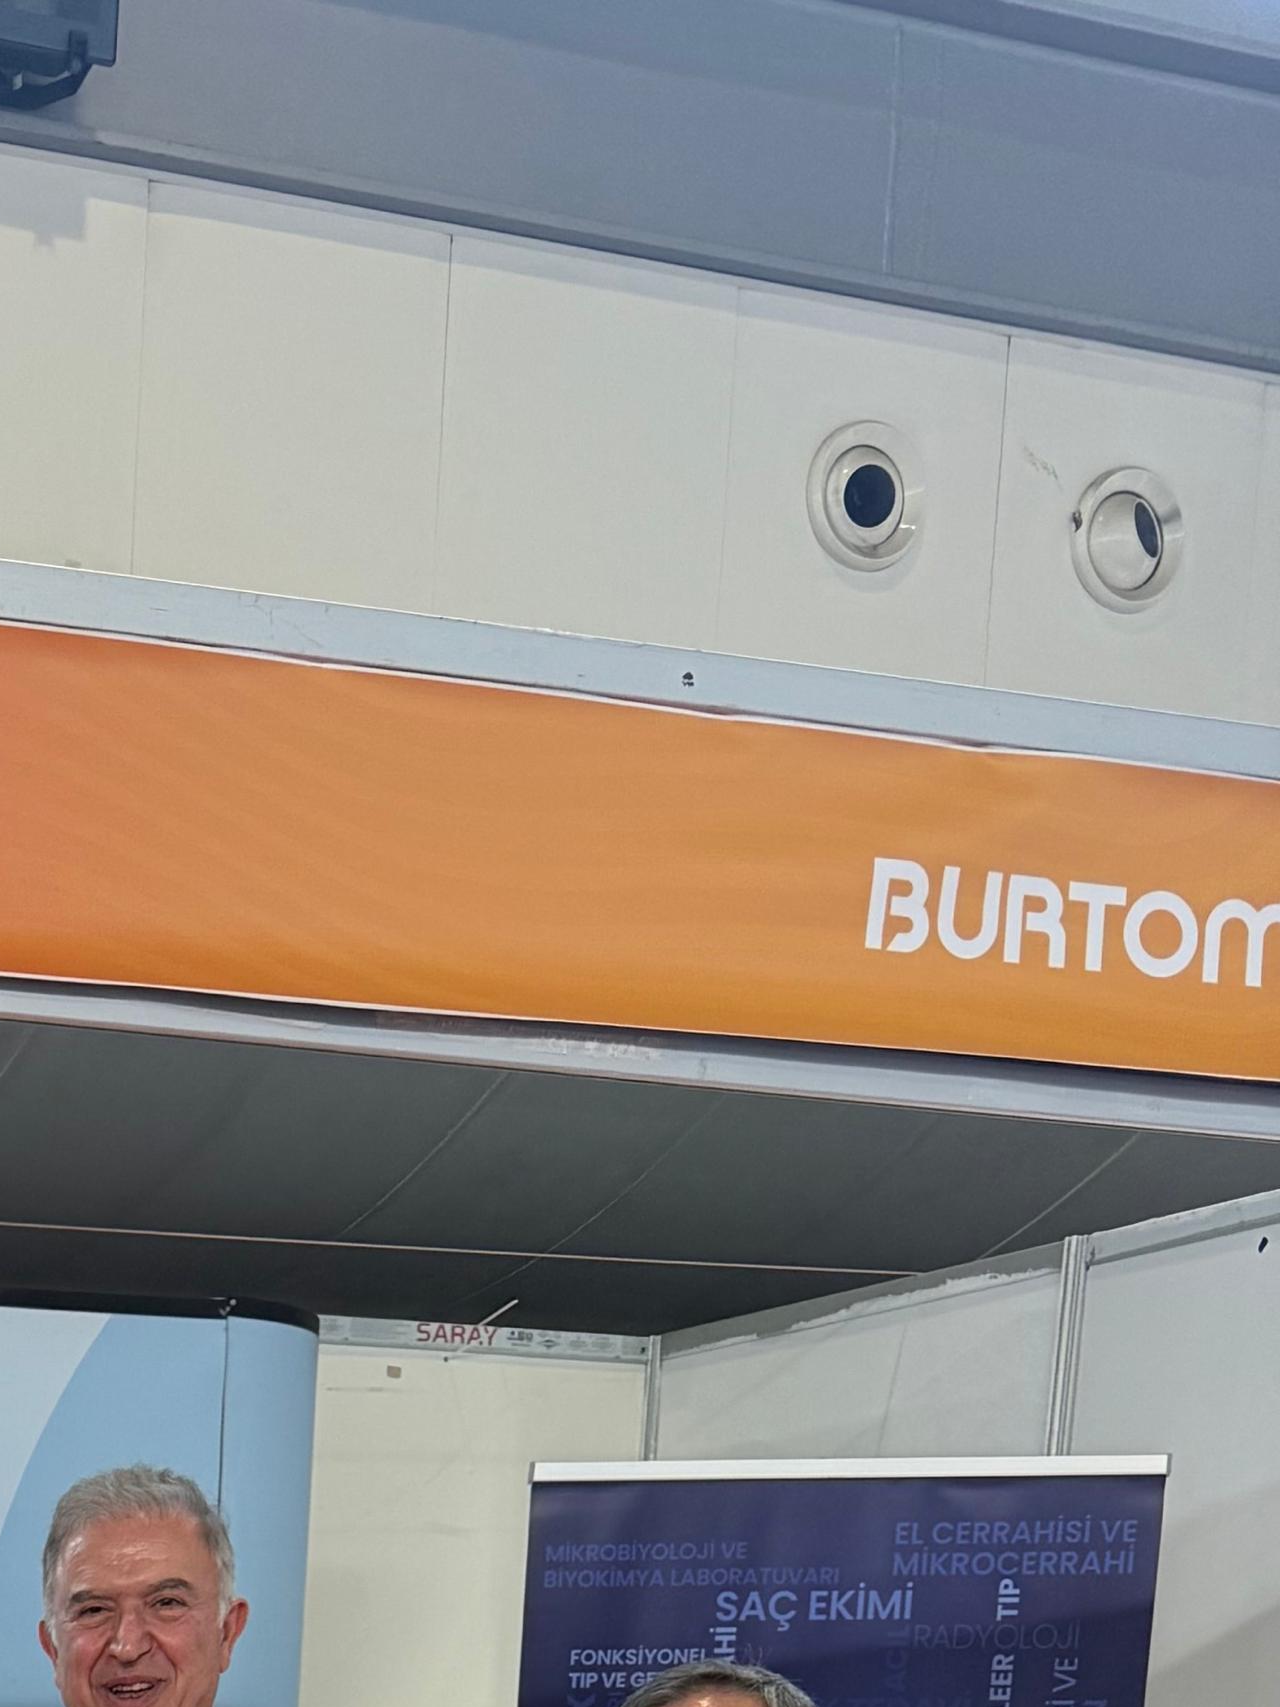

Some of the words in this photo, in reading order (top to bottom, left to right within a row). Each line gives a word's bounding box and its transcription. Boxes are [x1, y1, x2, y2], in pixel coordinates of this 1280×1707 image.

[865, 857, 1280, 988] BURTOM
[416, 1323, 499, 1347] SARAY
[894, 1521, 925, 1546] EL
[931, 1514, 1092, 1545] CERRAHİSİ
[1100, 1519, 1139, 1543] VE
[544, 1540, 715, 1564] MİKROBİYOLOJİ
[720, 1541, 749, 1560] VE
[891, 1543, 1137, 1577] MİKROCERRAHİ
[543, 1565, 665, 1589] BİYOKİMYA
[670, 1566, 840, 1587] LABORATUVARI
[715, 1589, 798, 1632] SAÇ
[808, 1581, 914, 1622] EKİMİ
[994, 1577, 1021, 1622] TIP
[568, 1671, 598, 1690] TIP
[601, 1671, 627, 1690] VE
[1051, 1656, 1080, 1693] VE
